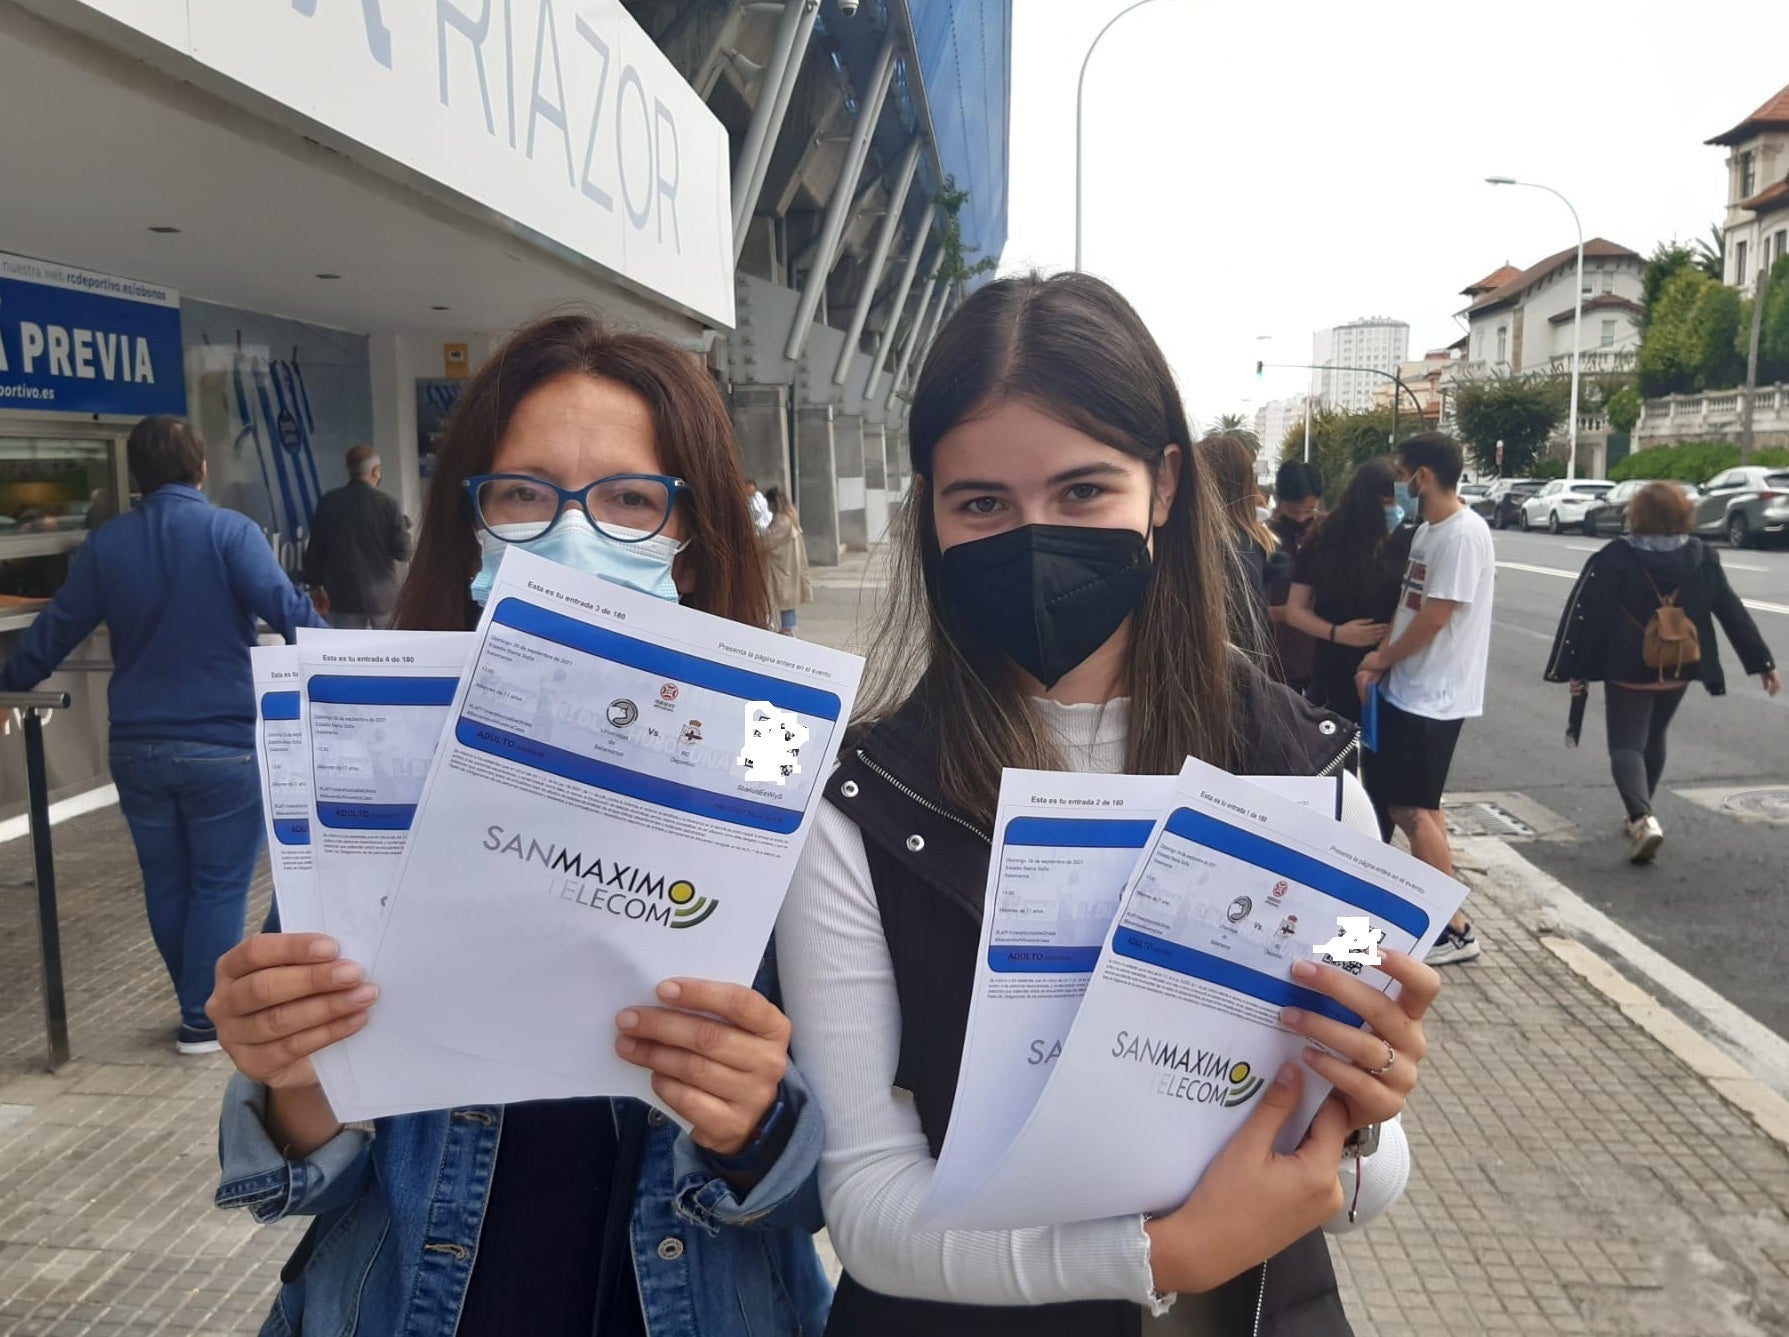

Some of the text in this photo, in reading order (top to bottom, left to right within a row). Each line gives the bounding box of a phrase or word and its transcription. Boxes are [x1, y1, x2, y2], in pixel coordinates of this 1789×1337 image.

[3, 260, 43, 278] nuestra
[66, 273, 166, 300] rcdeportivo.es/abonos
[20, 321, 155, 383] PREVIA
[527, 581, 544, 592] Esta
[545, 588, 554, 596] es
[556, 592, 563, 600] tu
[565, 595, 594, 610] entrada
[601, 607, 611, 615] de
[322, 654, 337, 662] Esta
[1031, 795, 1047, 804] Esta
